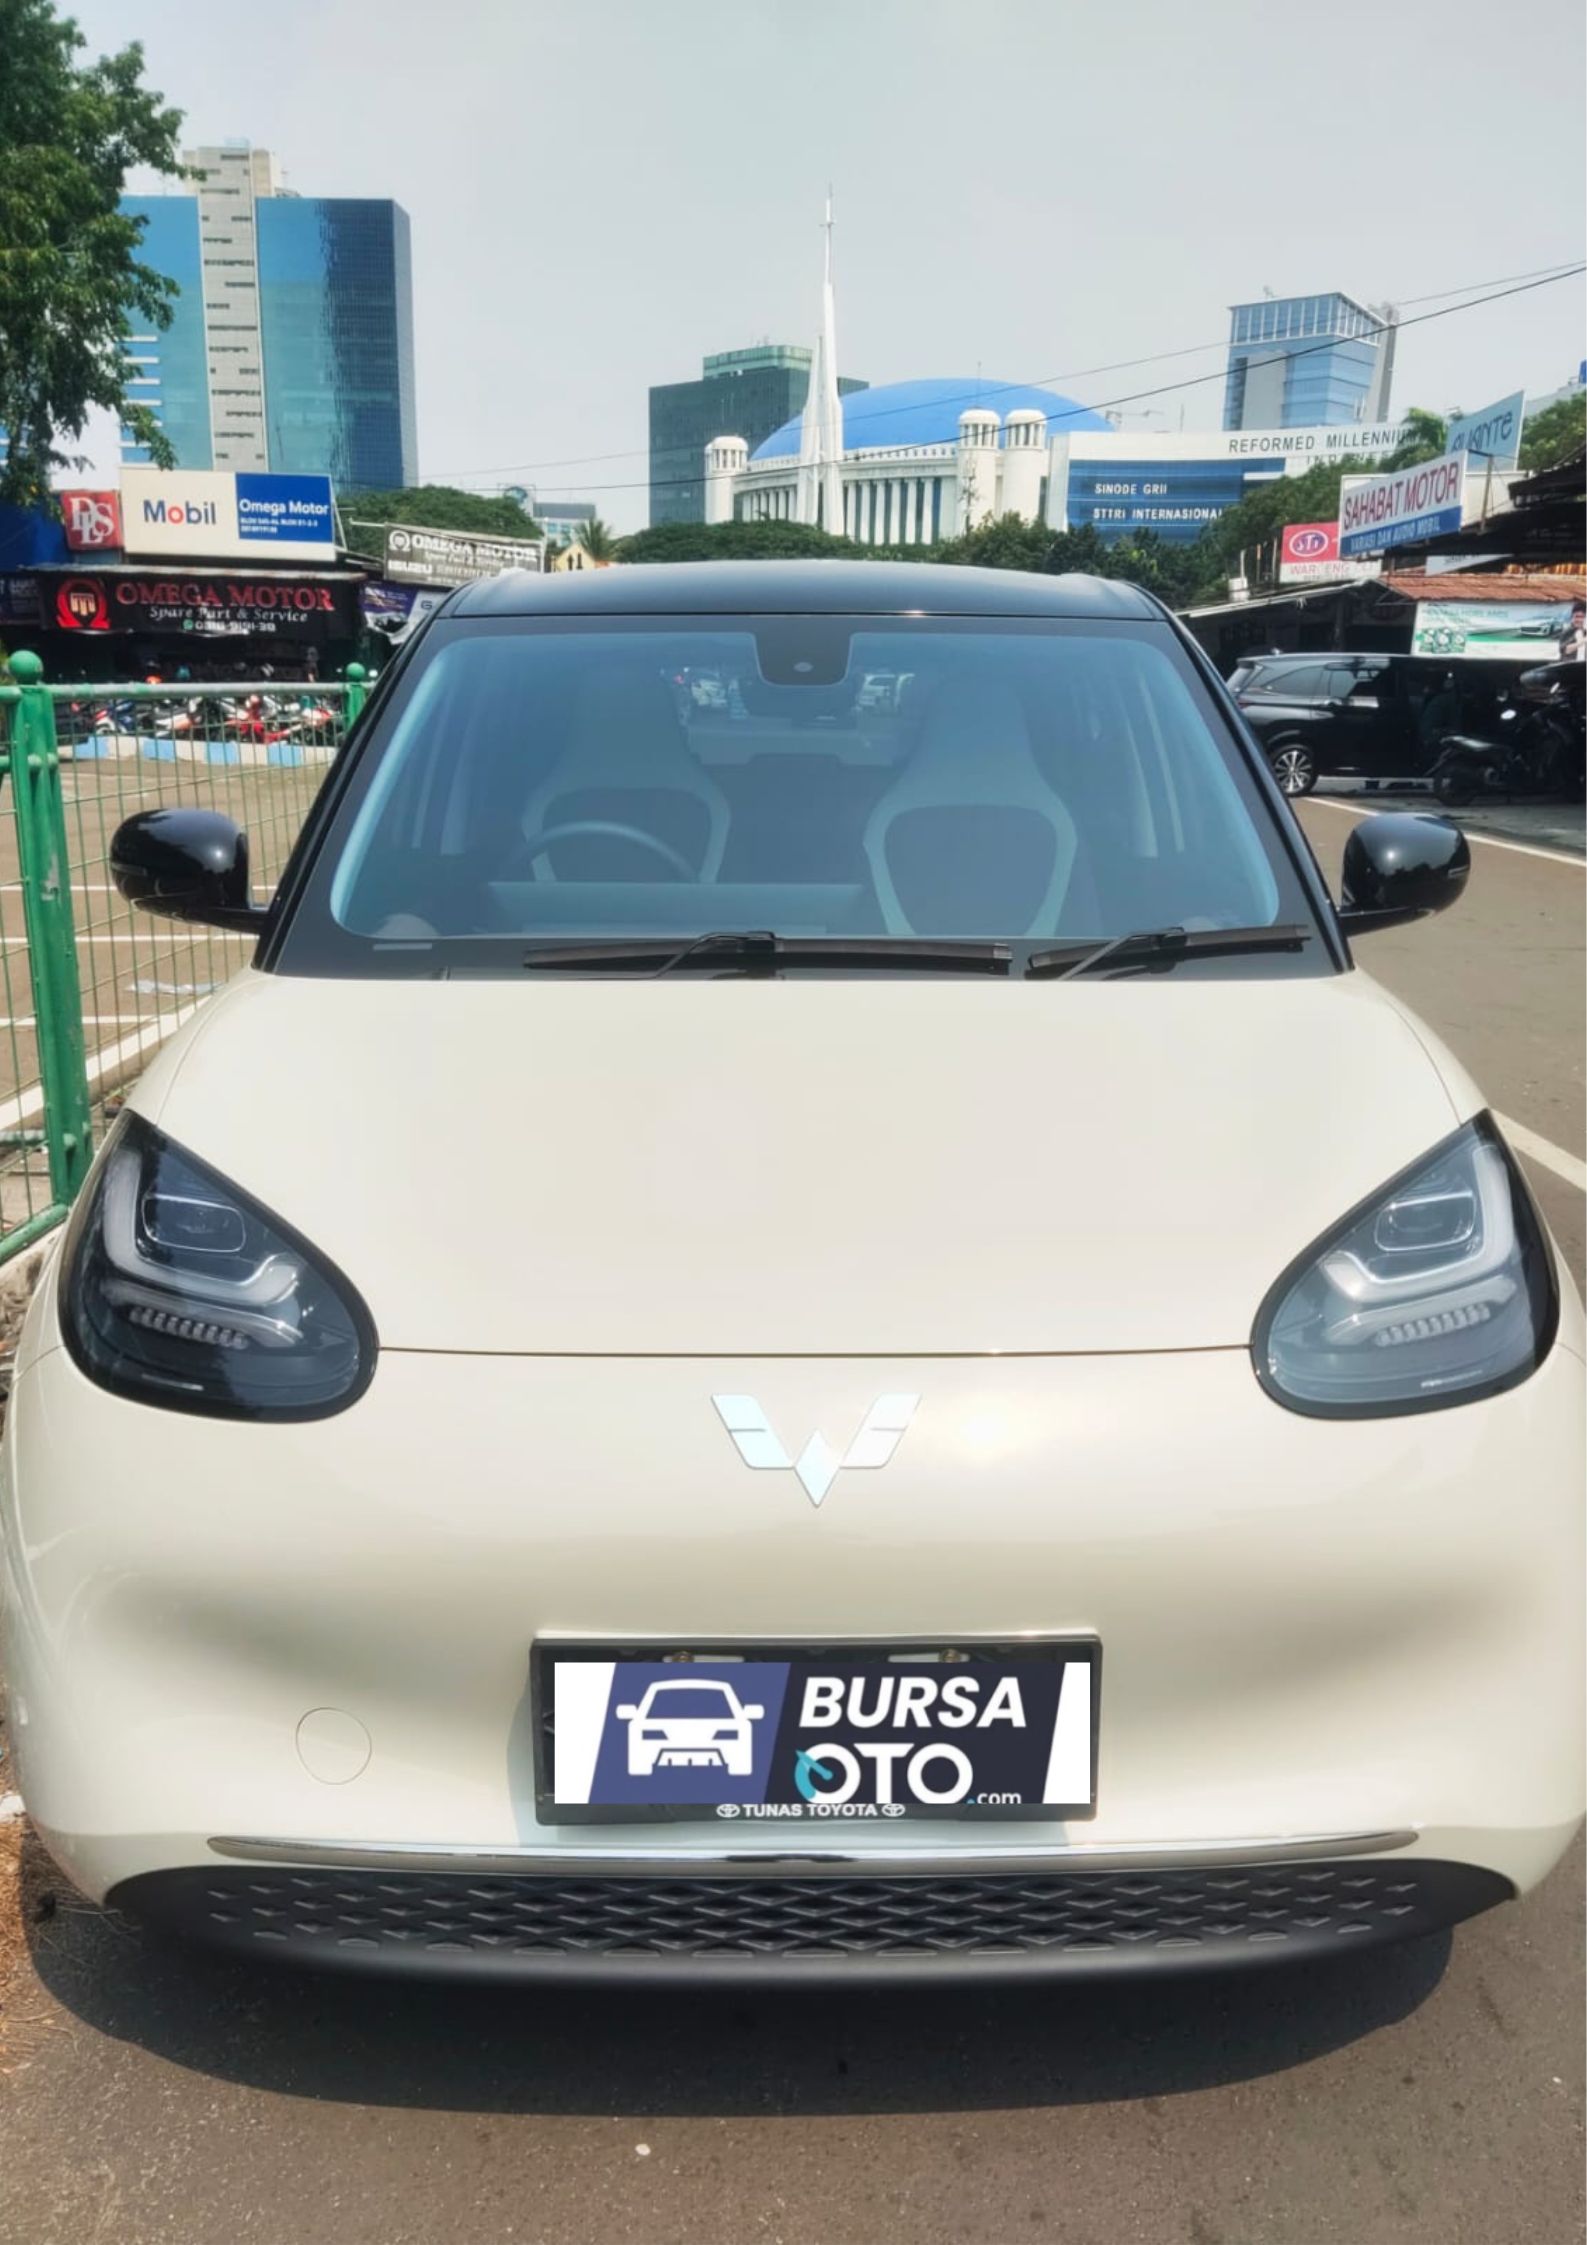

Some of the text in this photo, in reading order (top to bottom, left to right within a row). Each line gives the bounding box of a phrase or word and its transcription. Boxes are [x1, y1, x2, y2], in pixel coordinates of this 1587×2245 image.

[1228, 435, 1315, 453] REFORMED
[1095, 483, 1137, 495] SINODE
[1344, 461, 1460, 531] SAHABAT MOTOR
[143, 500, 216, 525] Mobil
[239, 498, 329, 517] Omega Motor
[115, 581, 224, 607] OMEGA
[226, 585, 335, 611] MOTOR
[150, 606, 309, 623] Spare Part & Service
[744, 1803, 879, 1818] TUNAS TOYOTA
